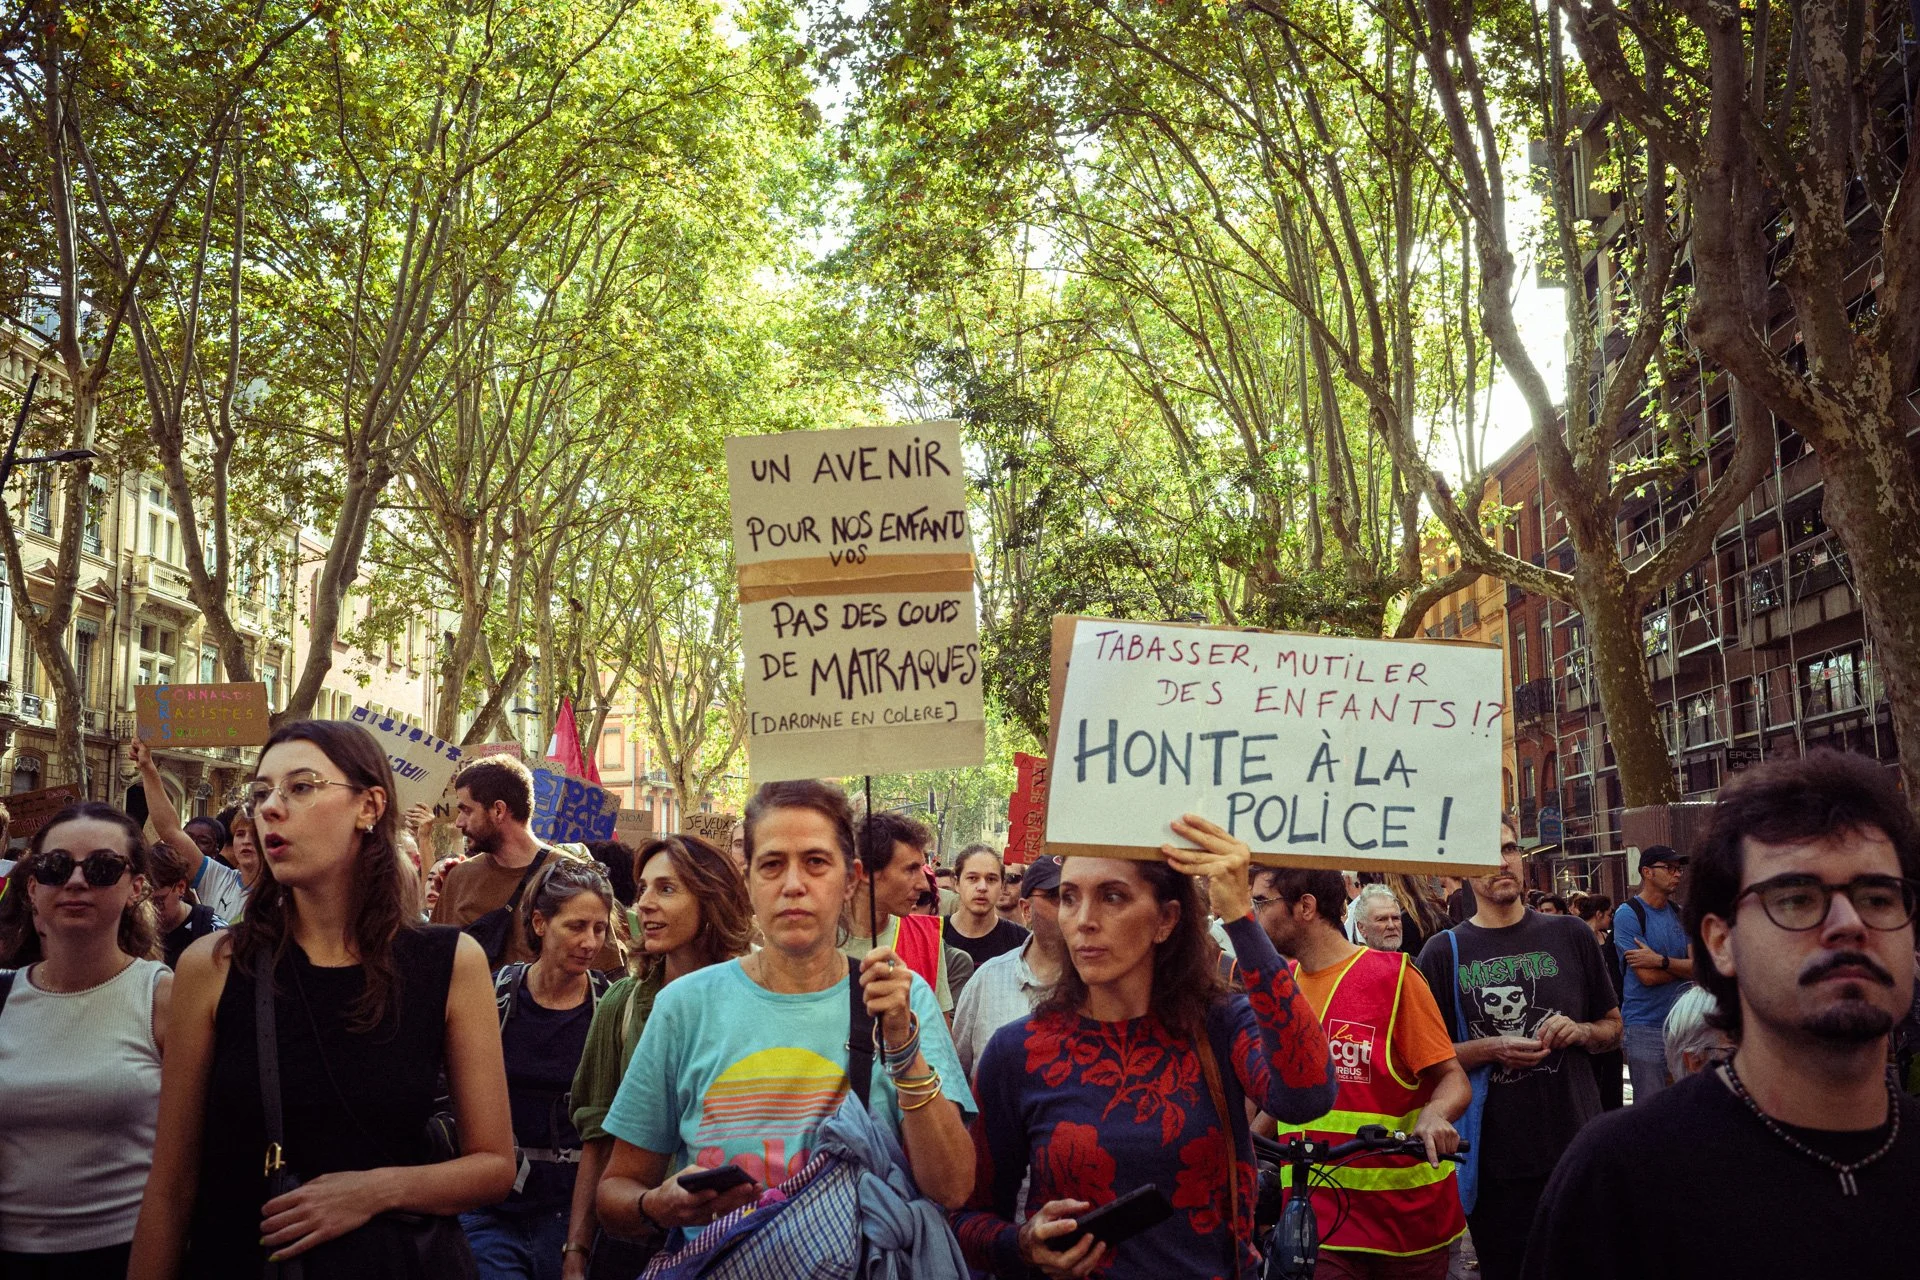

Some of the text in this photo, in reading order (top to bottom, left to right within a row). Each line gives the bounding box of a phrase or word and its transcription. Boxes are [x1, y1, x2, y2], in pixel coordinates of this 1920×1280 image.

[751, 455, 791, 484] UN
[746, 516, 820, 551] POUR
[831, 510, 874, 545] NOS
[829, 544, 868, 567] VOS
[771, 600, 960, 639] PAS DES COUPS
[1095, 629, 1259, 674] TABASSER,
[759, 644, 978, 700] DE MATRAQUES
[1157, 678, 1224, 706] DES
[851, 711, 874, 726] EN
[1074, 719, 1418, 788] HONTE À LA
[1730, 750, 1760, 759] EPICE
[686, 815, 730, 831] JE VEUX
[1458, 951, 1559, 994] MISFITS
[1329, 1040, 1371, 1067] cgt
